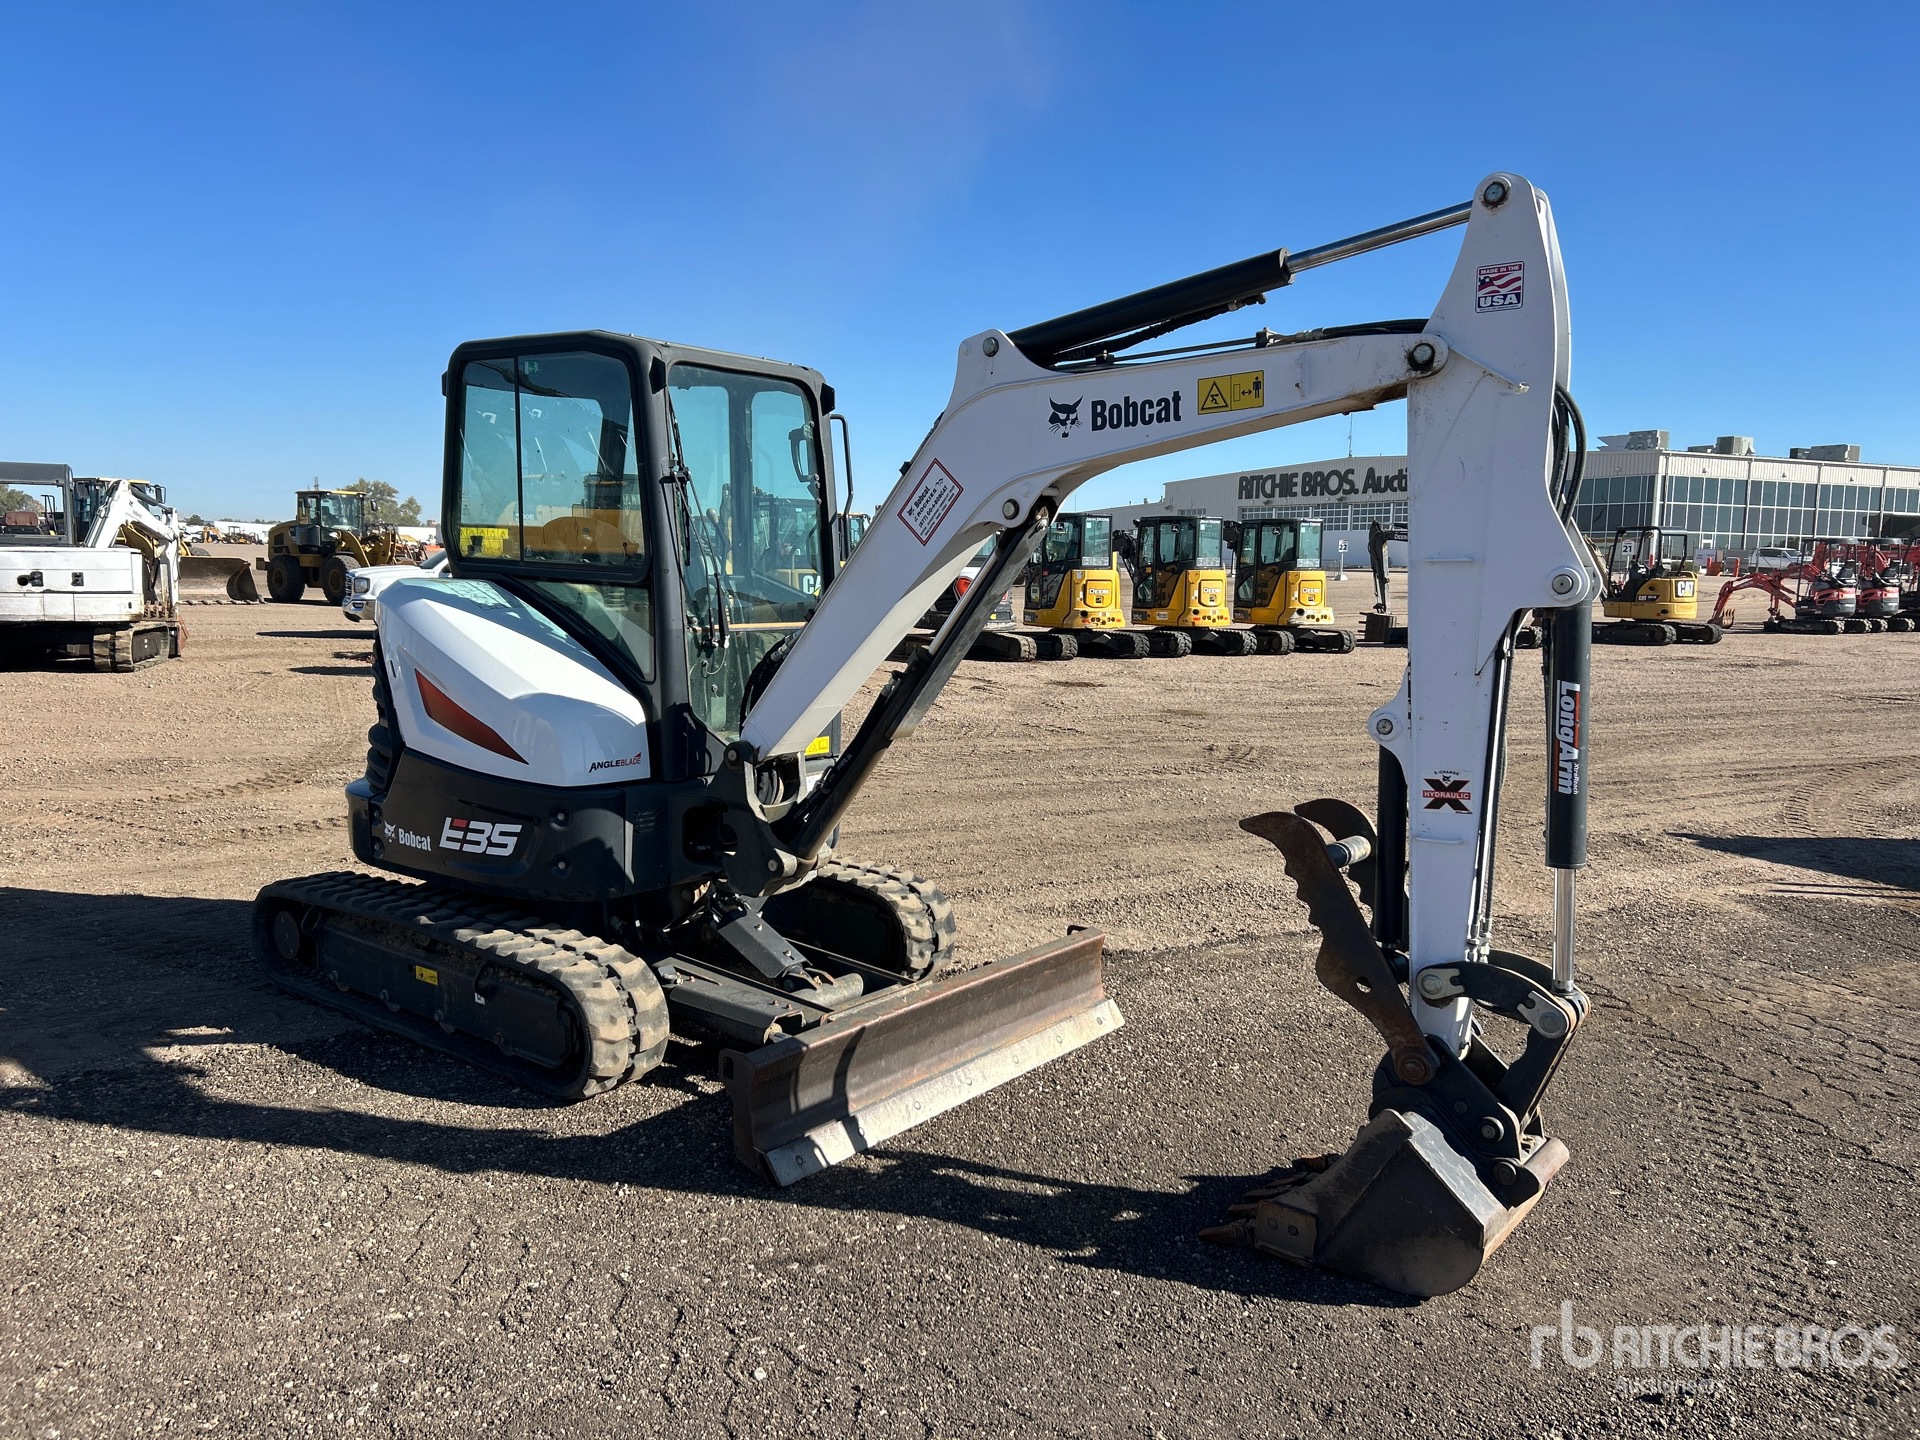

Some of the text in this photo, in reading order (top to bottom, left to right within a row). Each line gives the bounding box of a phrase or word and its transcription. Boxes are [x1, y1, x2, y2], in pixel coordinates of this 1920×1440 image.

[1480, 267, 1499, 275] MADE
[1479, 293, 1518, 308] USA
[1091, 390, 1182, 431] Bobcat
[1238, 471, 1298, 499] RITCHIE
[1300, 468, 1359, 497] BROS.
[914, 485, 930, 509] Bobcat
[916, 488, 937, 518] ROCKIES
[1622, 545, 1632, 553] 21
[1089, 587, 1110, 595] DEERE
[1677, 581, 1695, 597] CAT
[1555, 680, 1581, 795] LongArm
[589, 753, 642, 773] ANGLEBLADE
[1424, 791, 1470, 799] HYDRAULIC
[398, 828, 432, 852] Bobcat
[438, 816, 523, 857] E35
